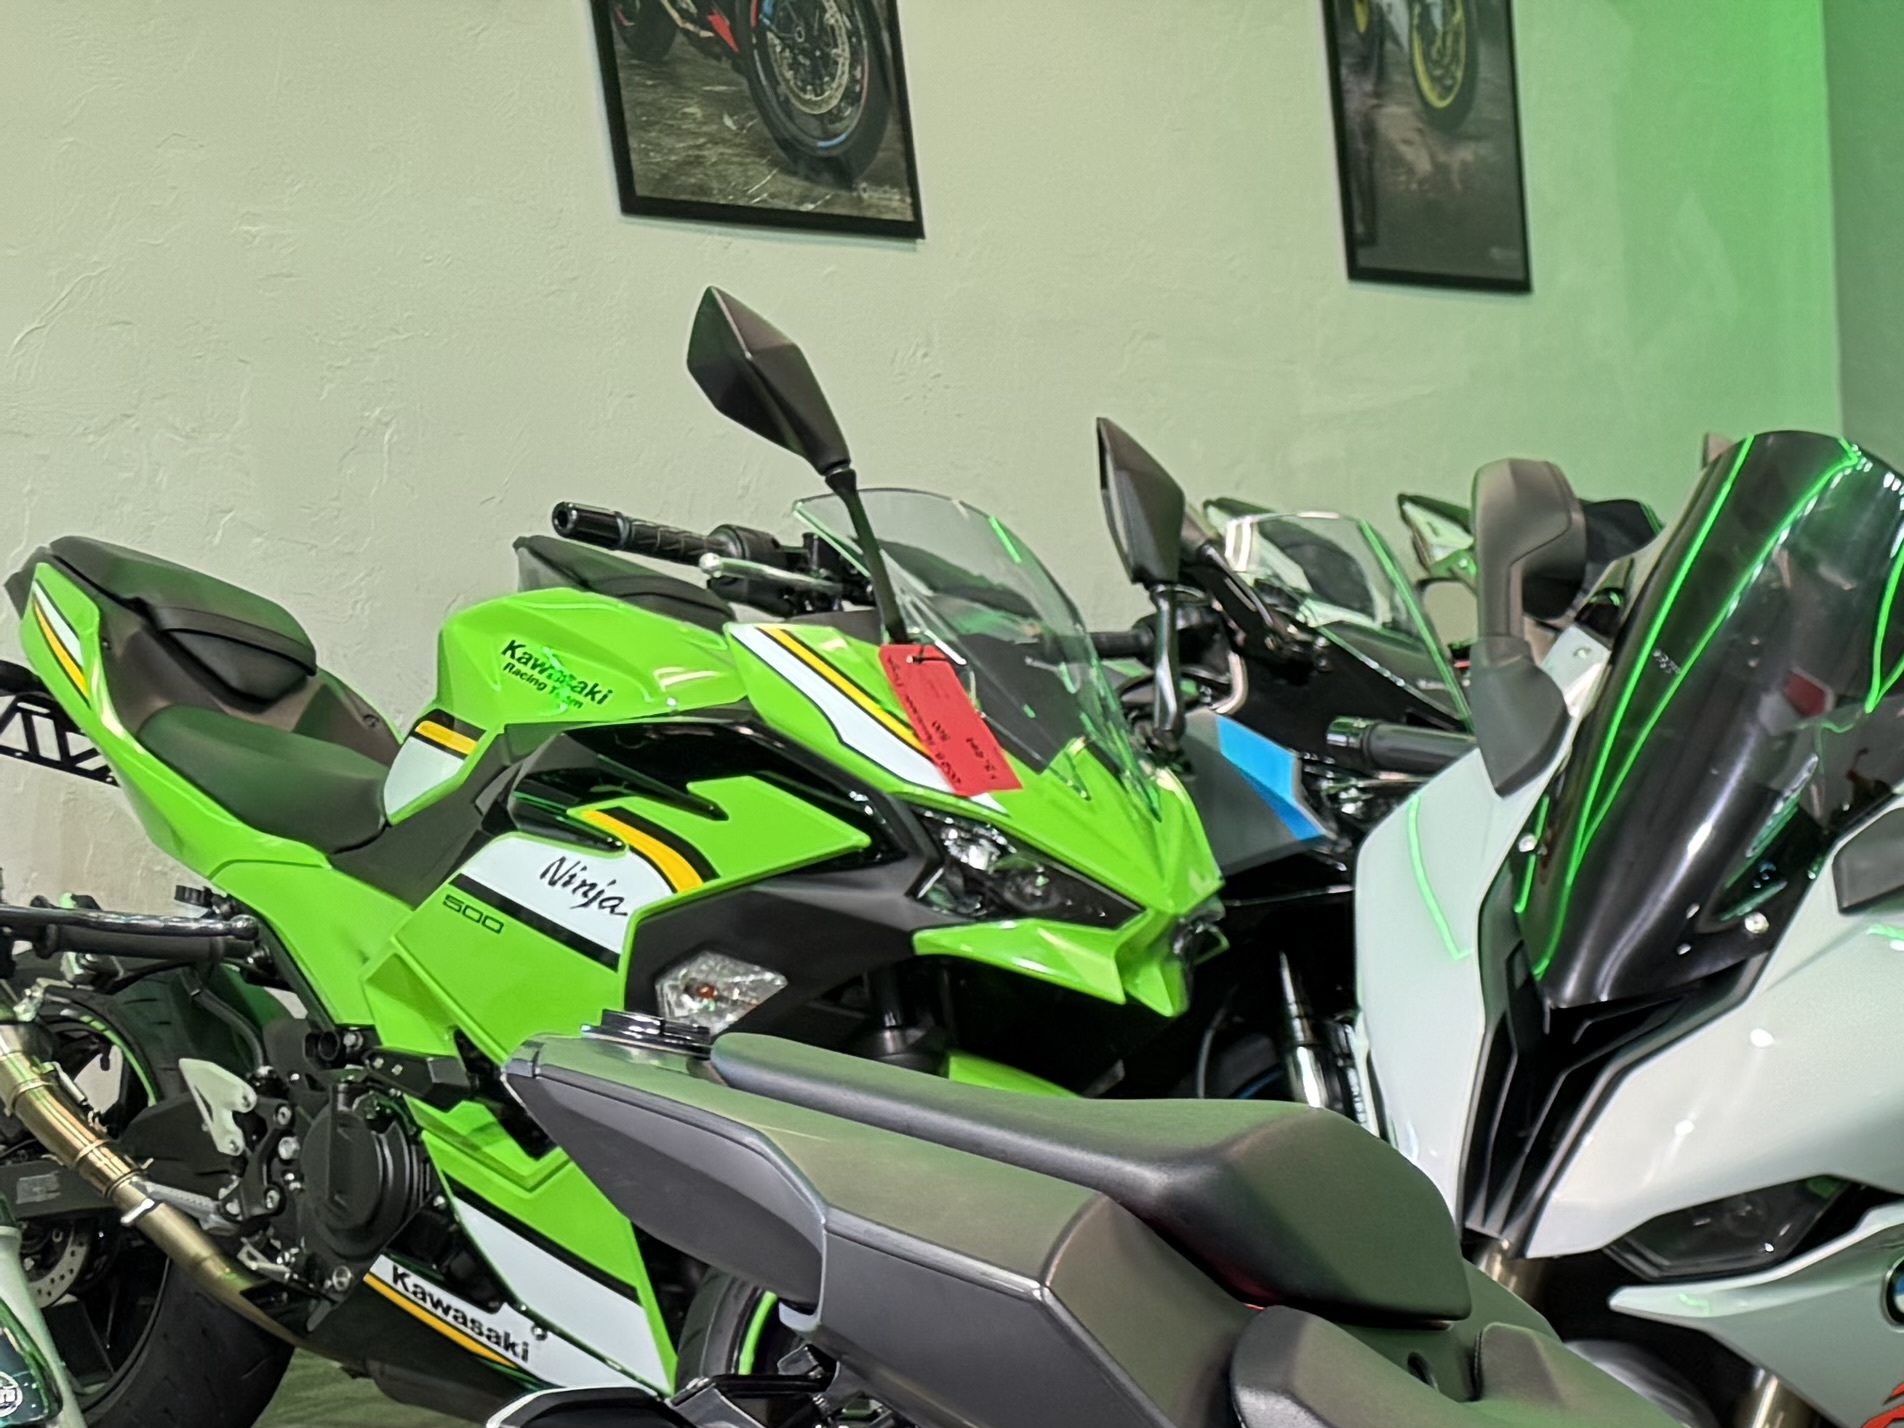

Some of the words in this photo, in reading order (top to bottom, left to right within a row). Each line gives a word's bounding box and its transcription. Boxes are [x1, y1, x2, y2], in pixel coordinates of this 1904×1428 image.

[503, 661, 548, 692] Racing
[539, 855, 628, 916] Ninja
[442, 893, 505, 935] 500
[392, 1263, 530, 1363] Kawasaki
